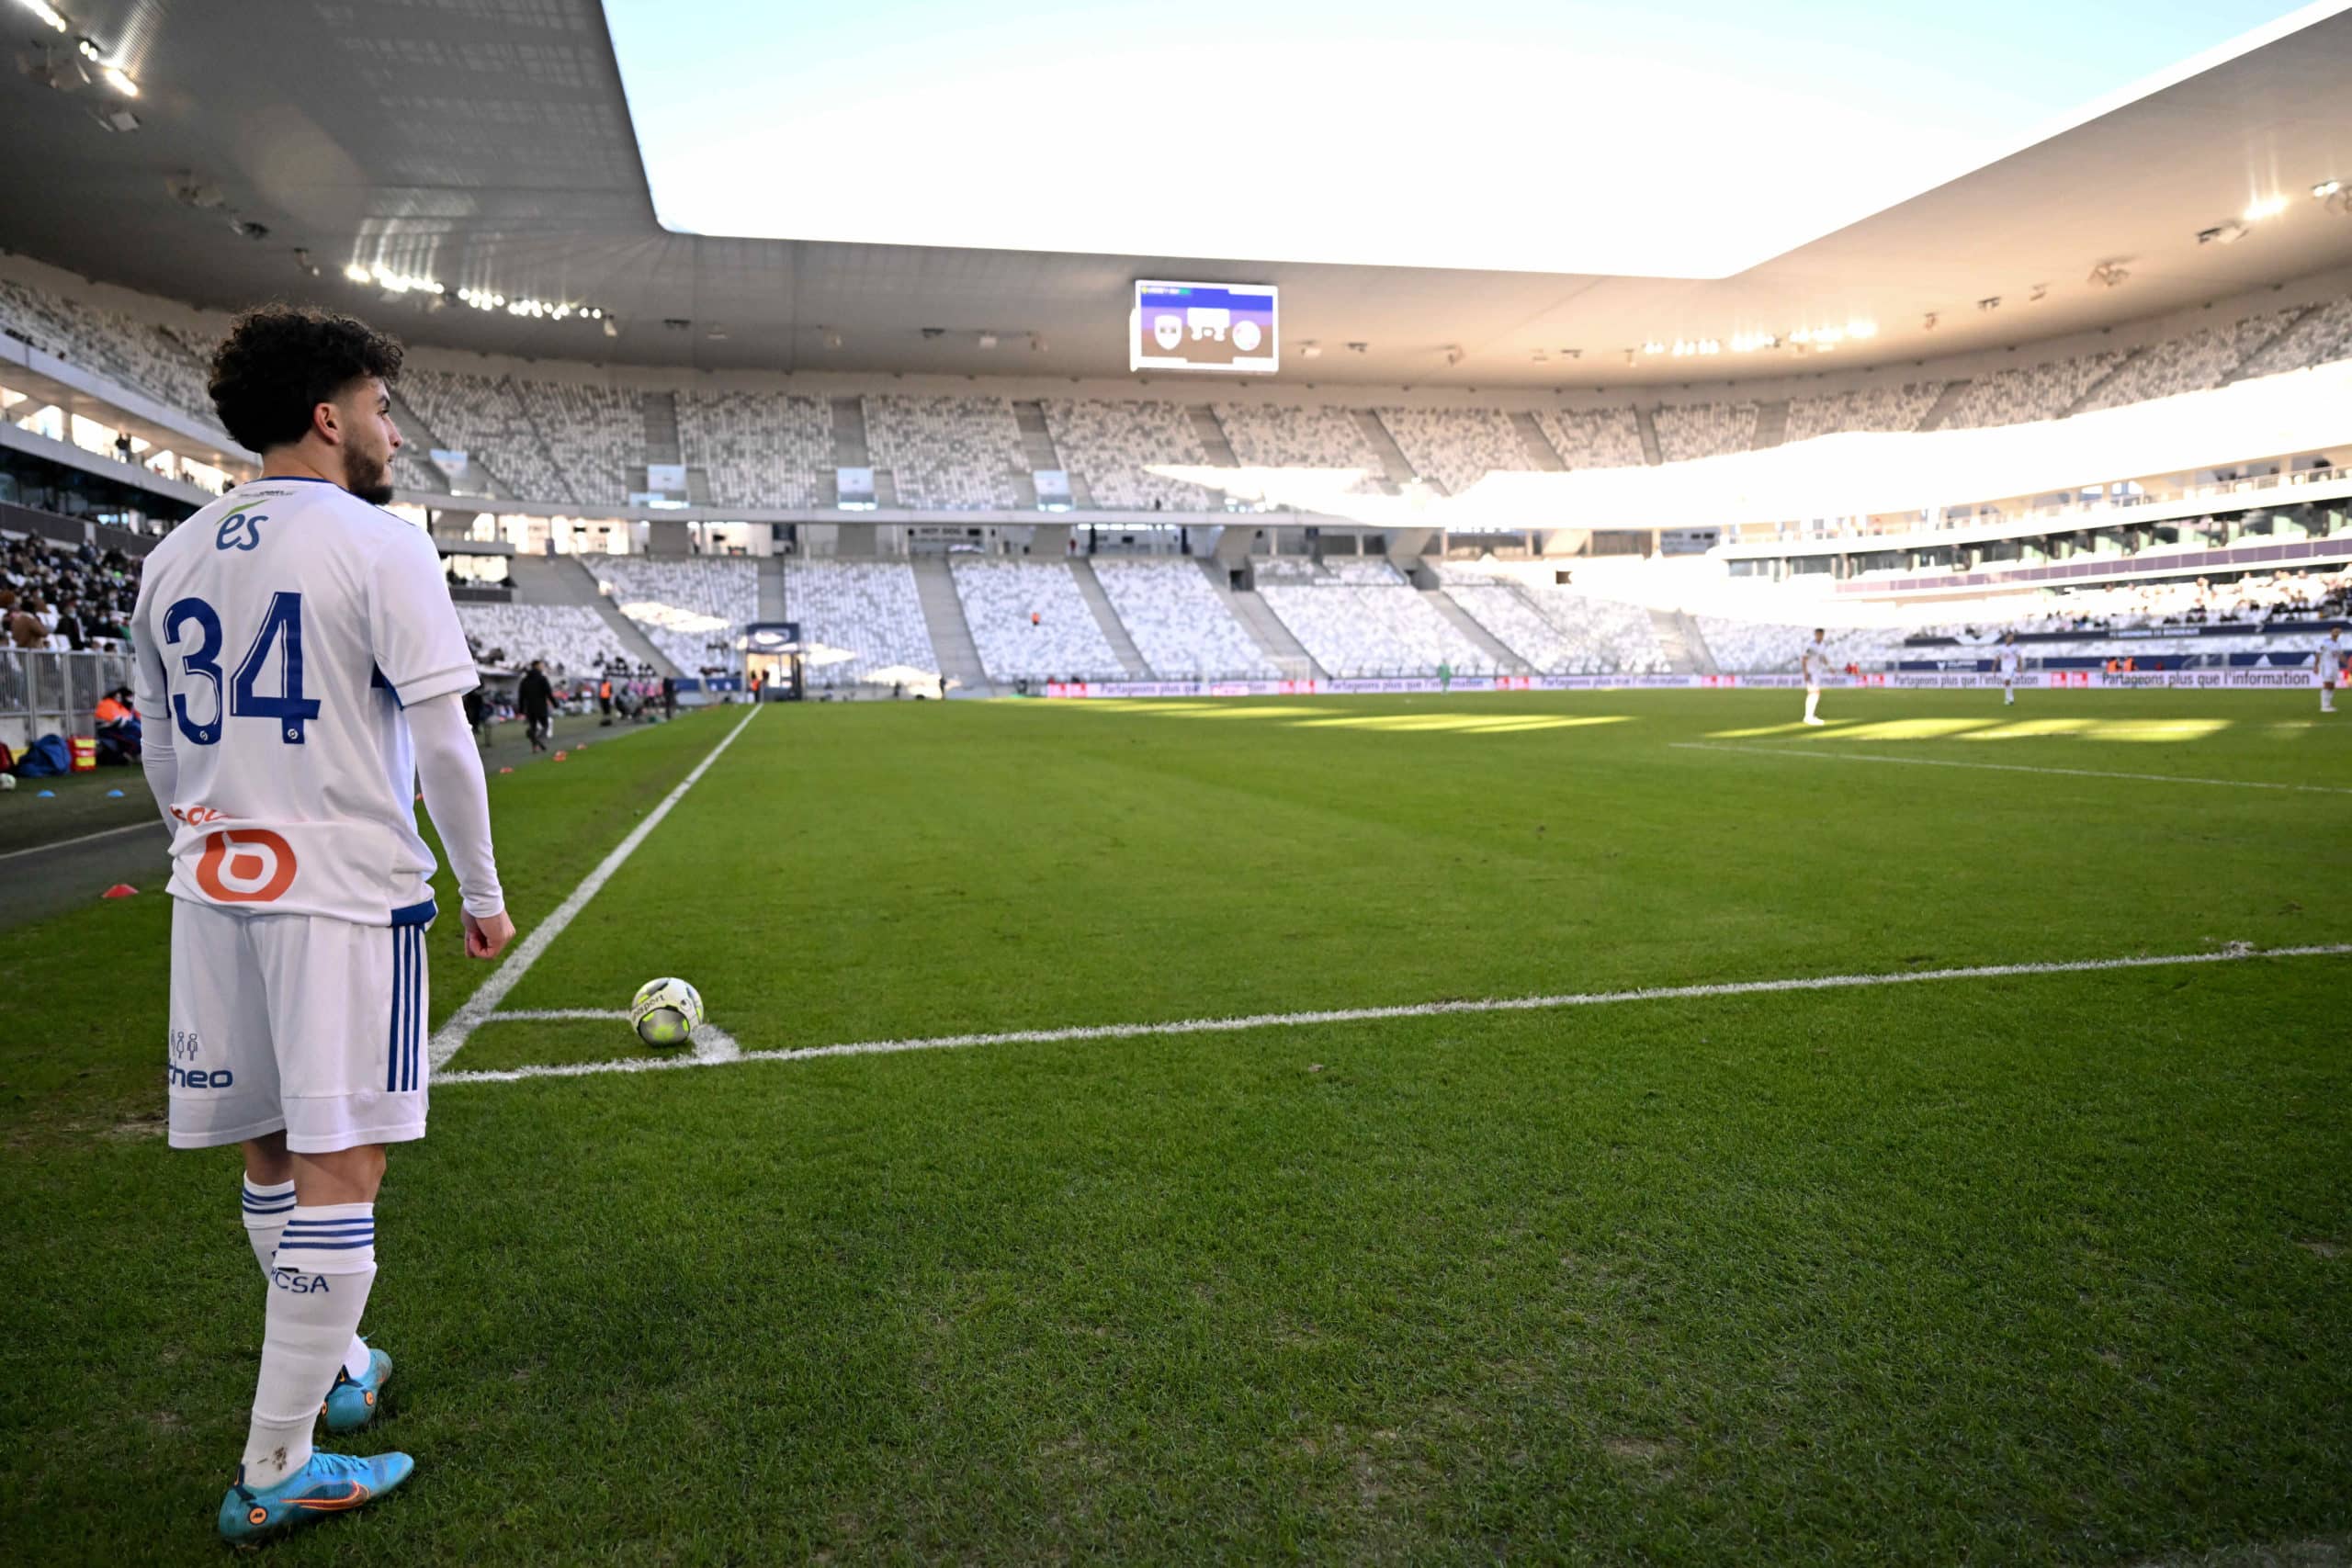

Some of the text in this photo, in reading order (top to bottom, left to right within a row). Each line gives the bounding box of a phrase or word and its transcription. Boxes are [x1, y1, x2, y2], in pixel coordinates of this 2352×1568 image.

[164, 592, 321, 745] 34
[1894, 675, 1938, 687] Partageons
[1940, 675, 1958, 687] plus
[1962, 678, 1977, 687] que
[2102, 671, 2310, 688] Partageons plus que l'information
